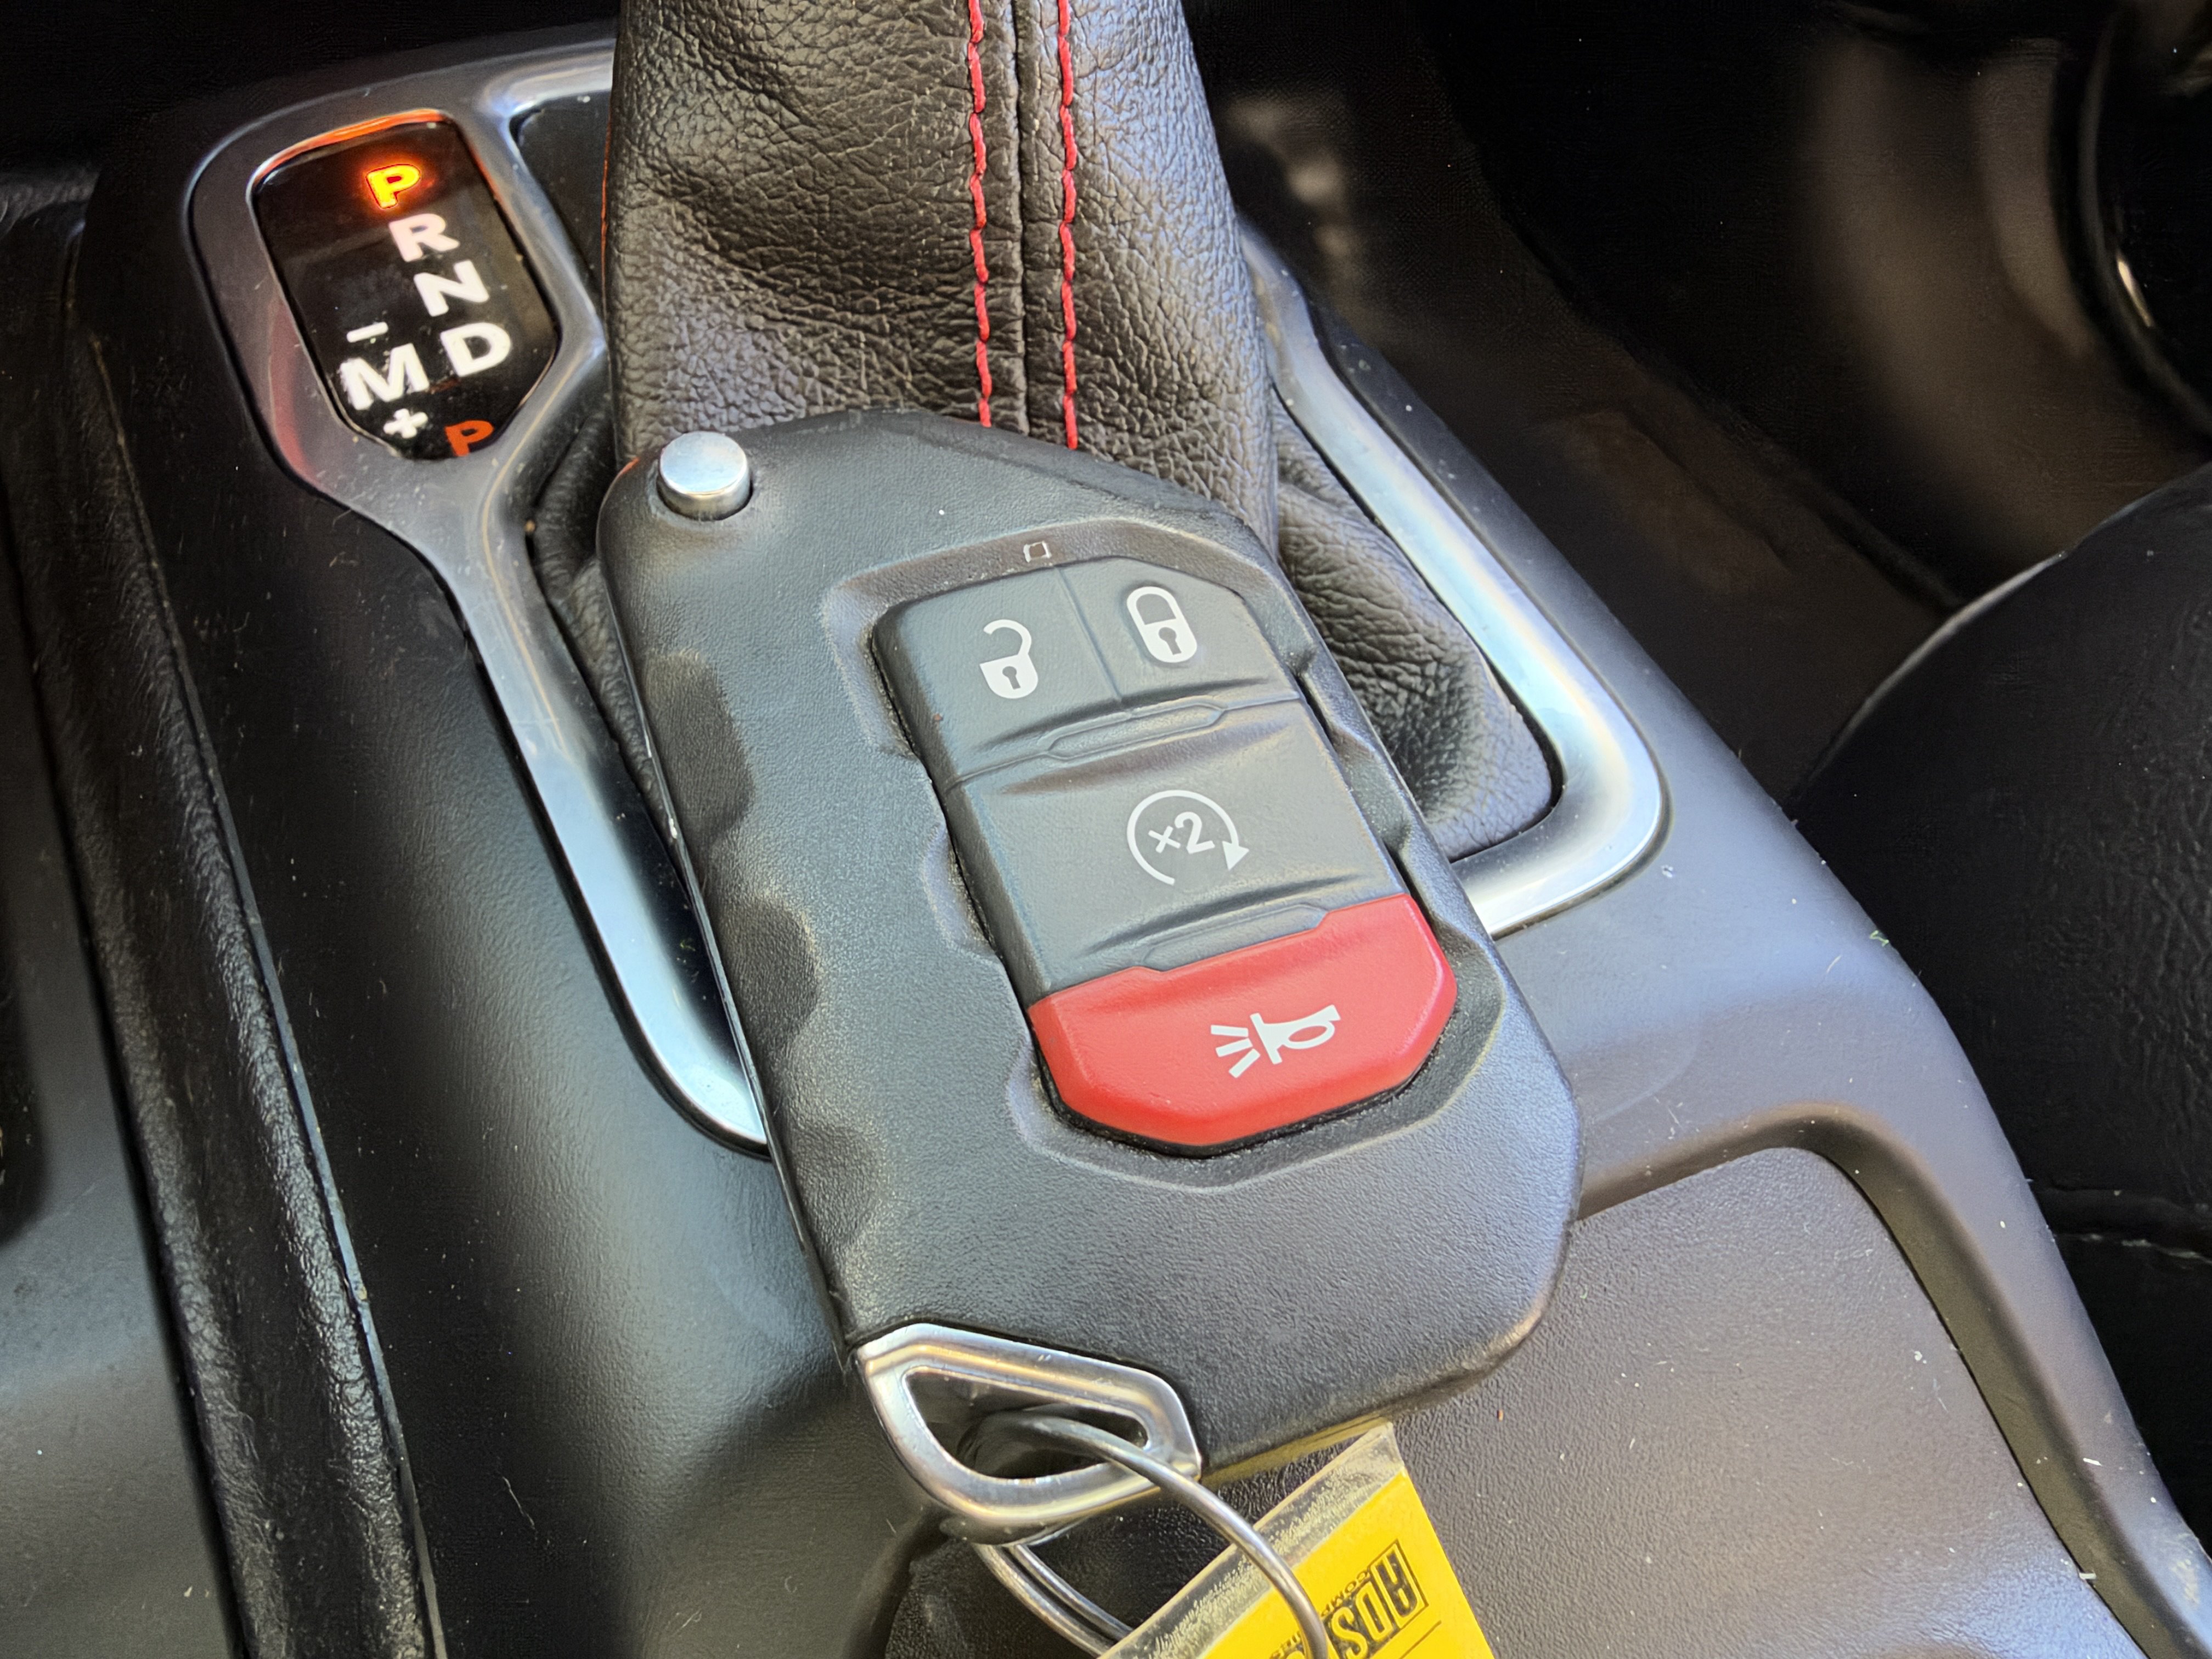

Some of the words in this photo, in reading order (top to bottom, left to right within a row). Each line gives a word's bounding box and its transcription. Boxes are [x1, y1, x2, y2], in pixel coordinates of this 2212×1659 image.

[366, 163, 421, 210] P
[389, 213, 460, 262] R
[413, 259, 489, 317] N
[339, 343, 430, 410] M
[441, 322, 511, 377] D
[444, 420, 494, 456] P
